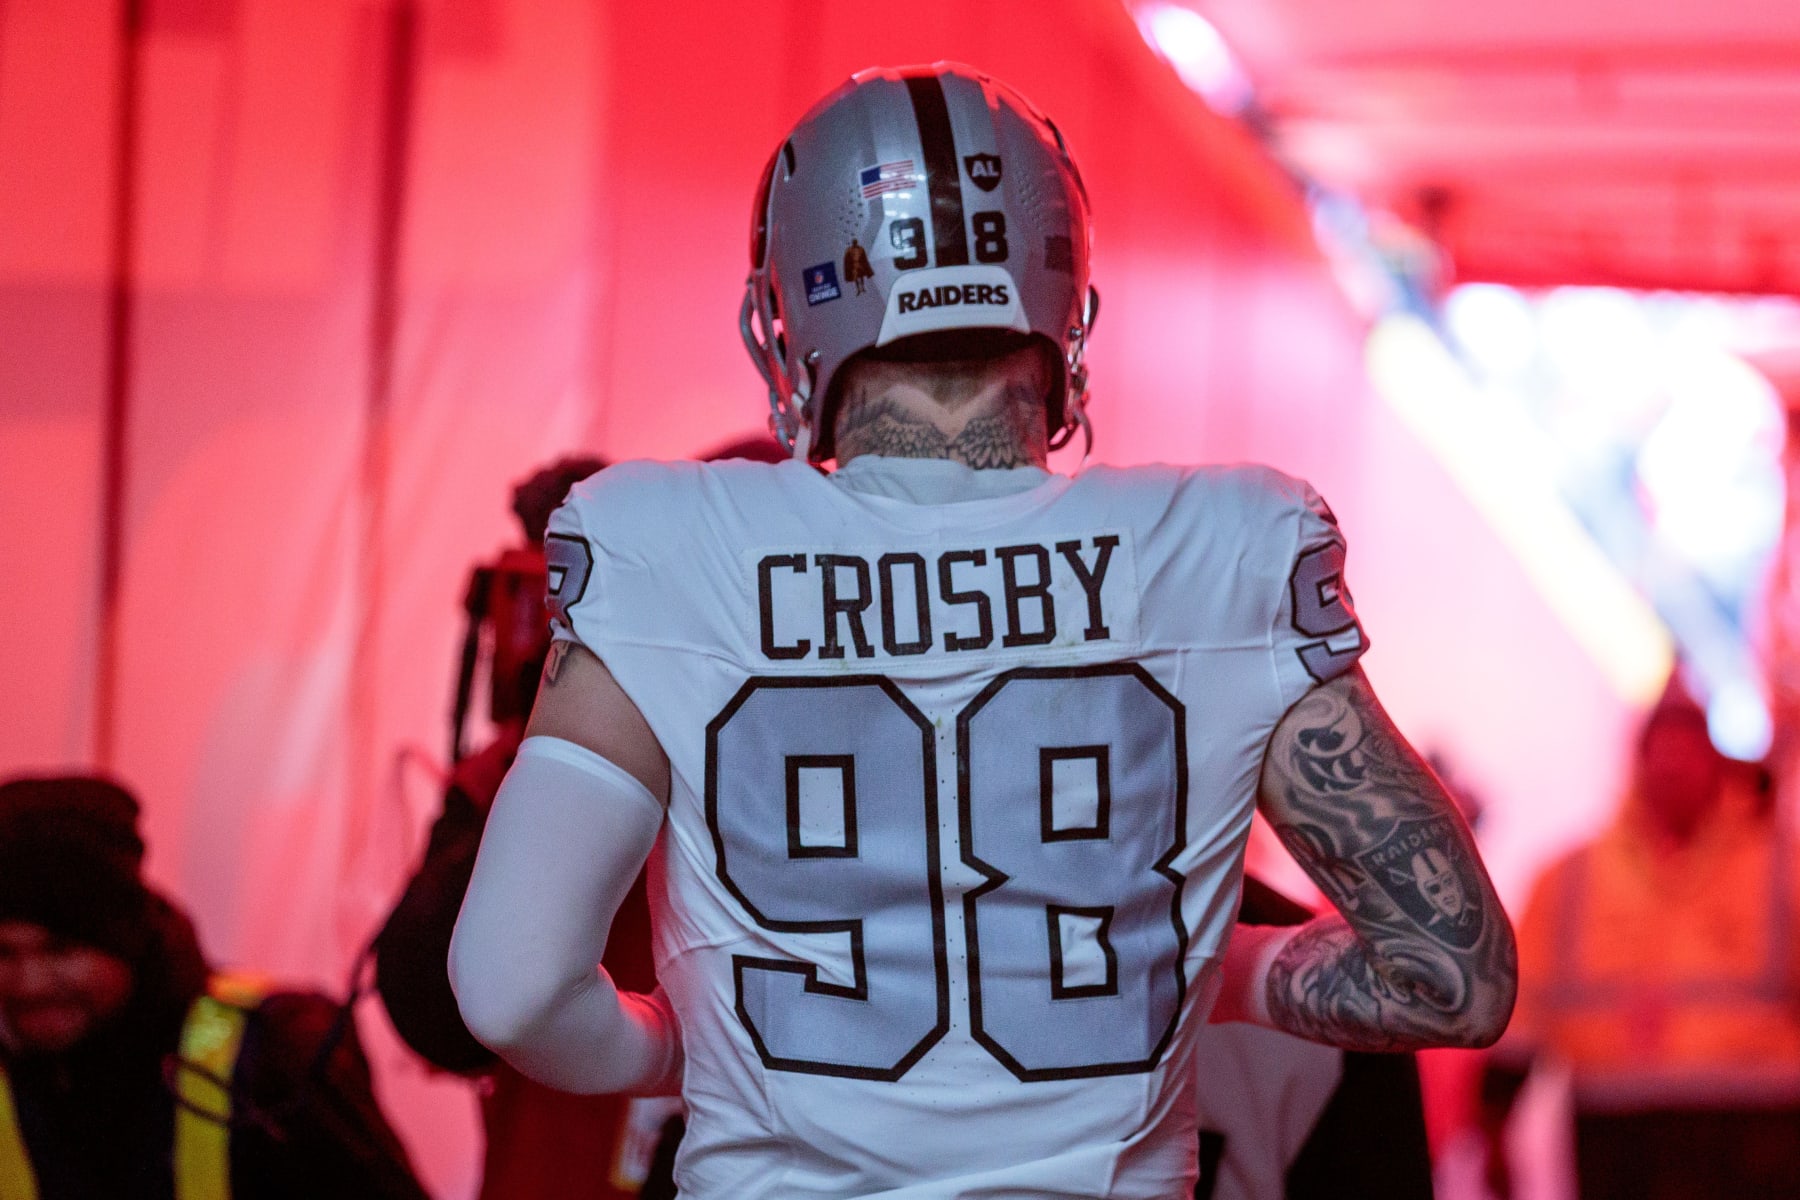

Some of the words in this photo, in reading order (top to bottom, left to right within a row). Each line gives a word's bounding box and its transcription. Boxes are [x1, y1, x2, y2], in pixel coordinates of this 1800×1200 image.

[971, 160, 999, 178] AL
[898, 284, 1010, 314] RAIDERS
[758, 535, 1120, 661] CROSBY
[705, 662, 1188, 1083] 98
